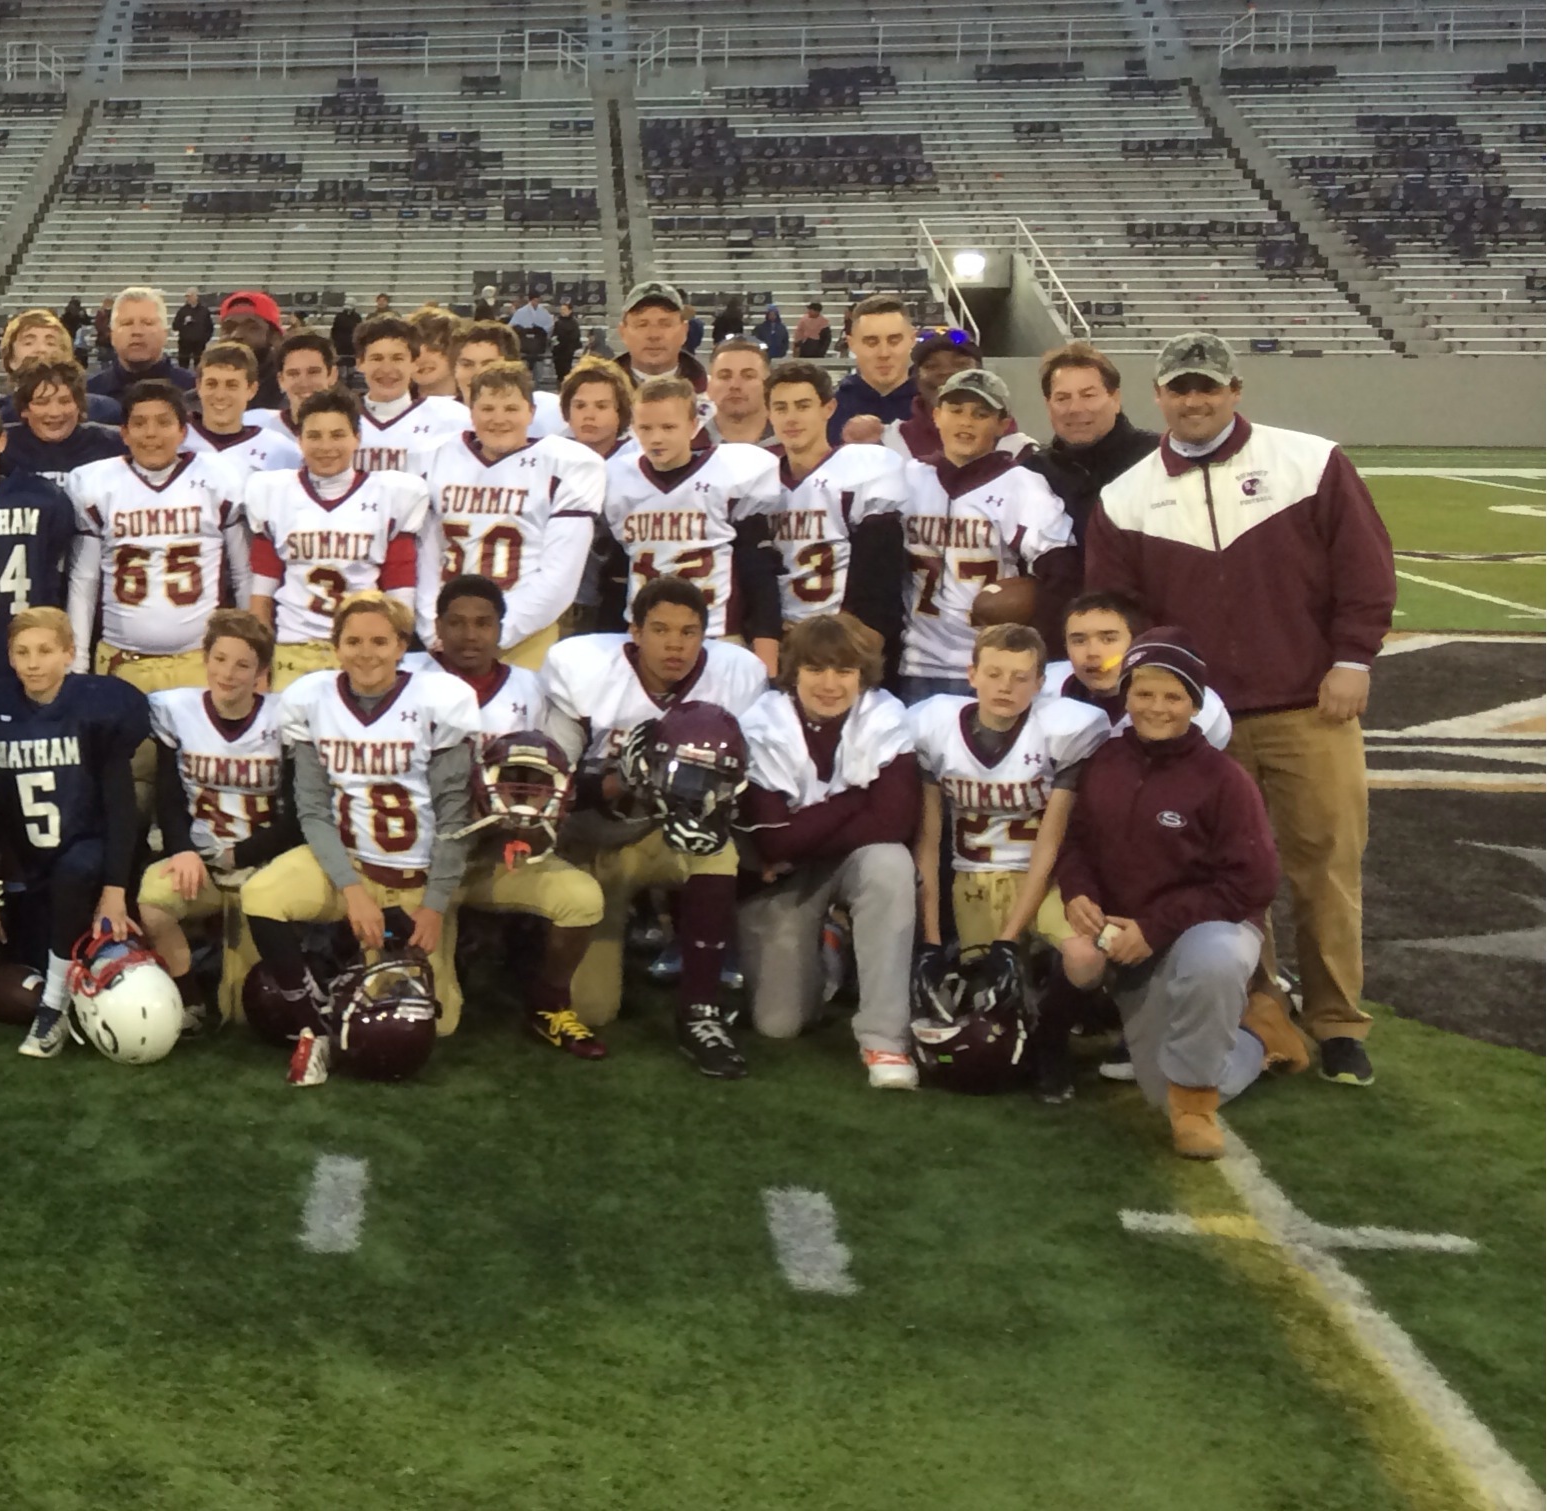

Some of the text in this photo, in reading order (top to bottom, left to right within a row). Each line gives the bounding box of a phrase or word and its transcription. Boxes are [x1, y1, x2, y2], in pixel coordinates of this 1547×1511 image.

[1181, 343, 1206, 361] A
[441, 484, 529, 516] SUMMIT
[113, 505, 203, 538] SUMMIT
[623, 510, 708, 543] SUMMIT
[907, 516, 994, 549] SUMMIT
[288, 531, 375, 562] SUMMIT
[440, 520, 524, 591] 50
[113, 543, 204, 606] 65
[306, 564, 349, 618] 3
[790, 543, 835, 604] 3
[910, 554, 999, 628] 77
[181, 752, 278, 789] SUMMIT
[319, 738, 416, 776] SUMMIT
[15, 771, 61, 848] 5
[338, 783, 419, 856] 18
